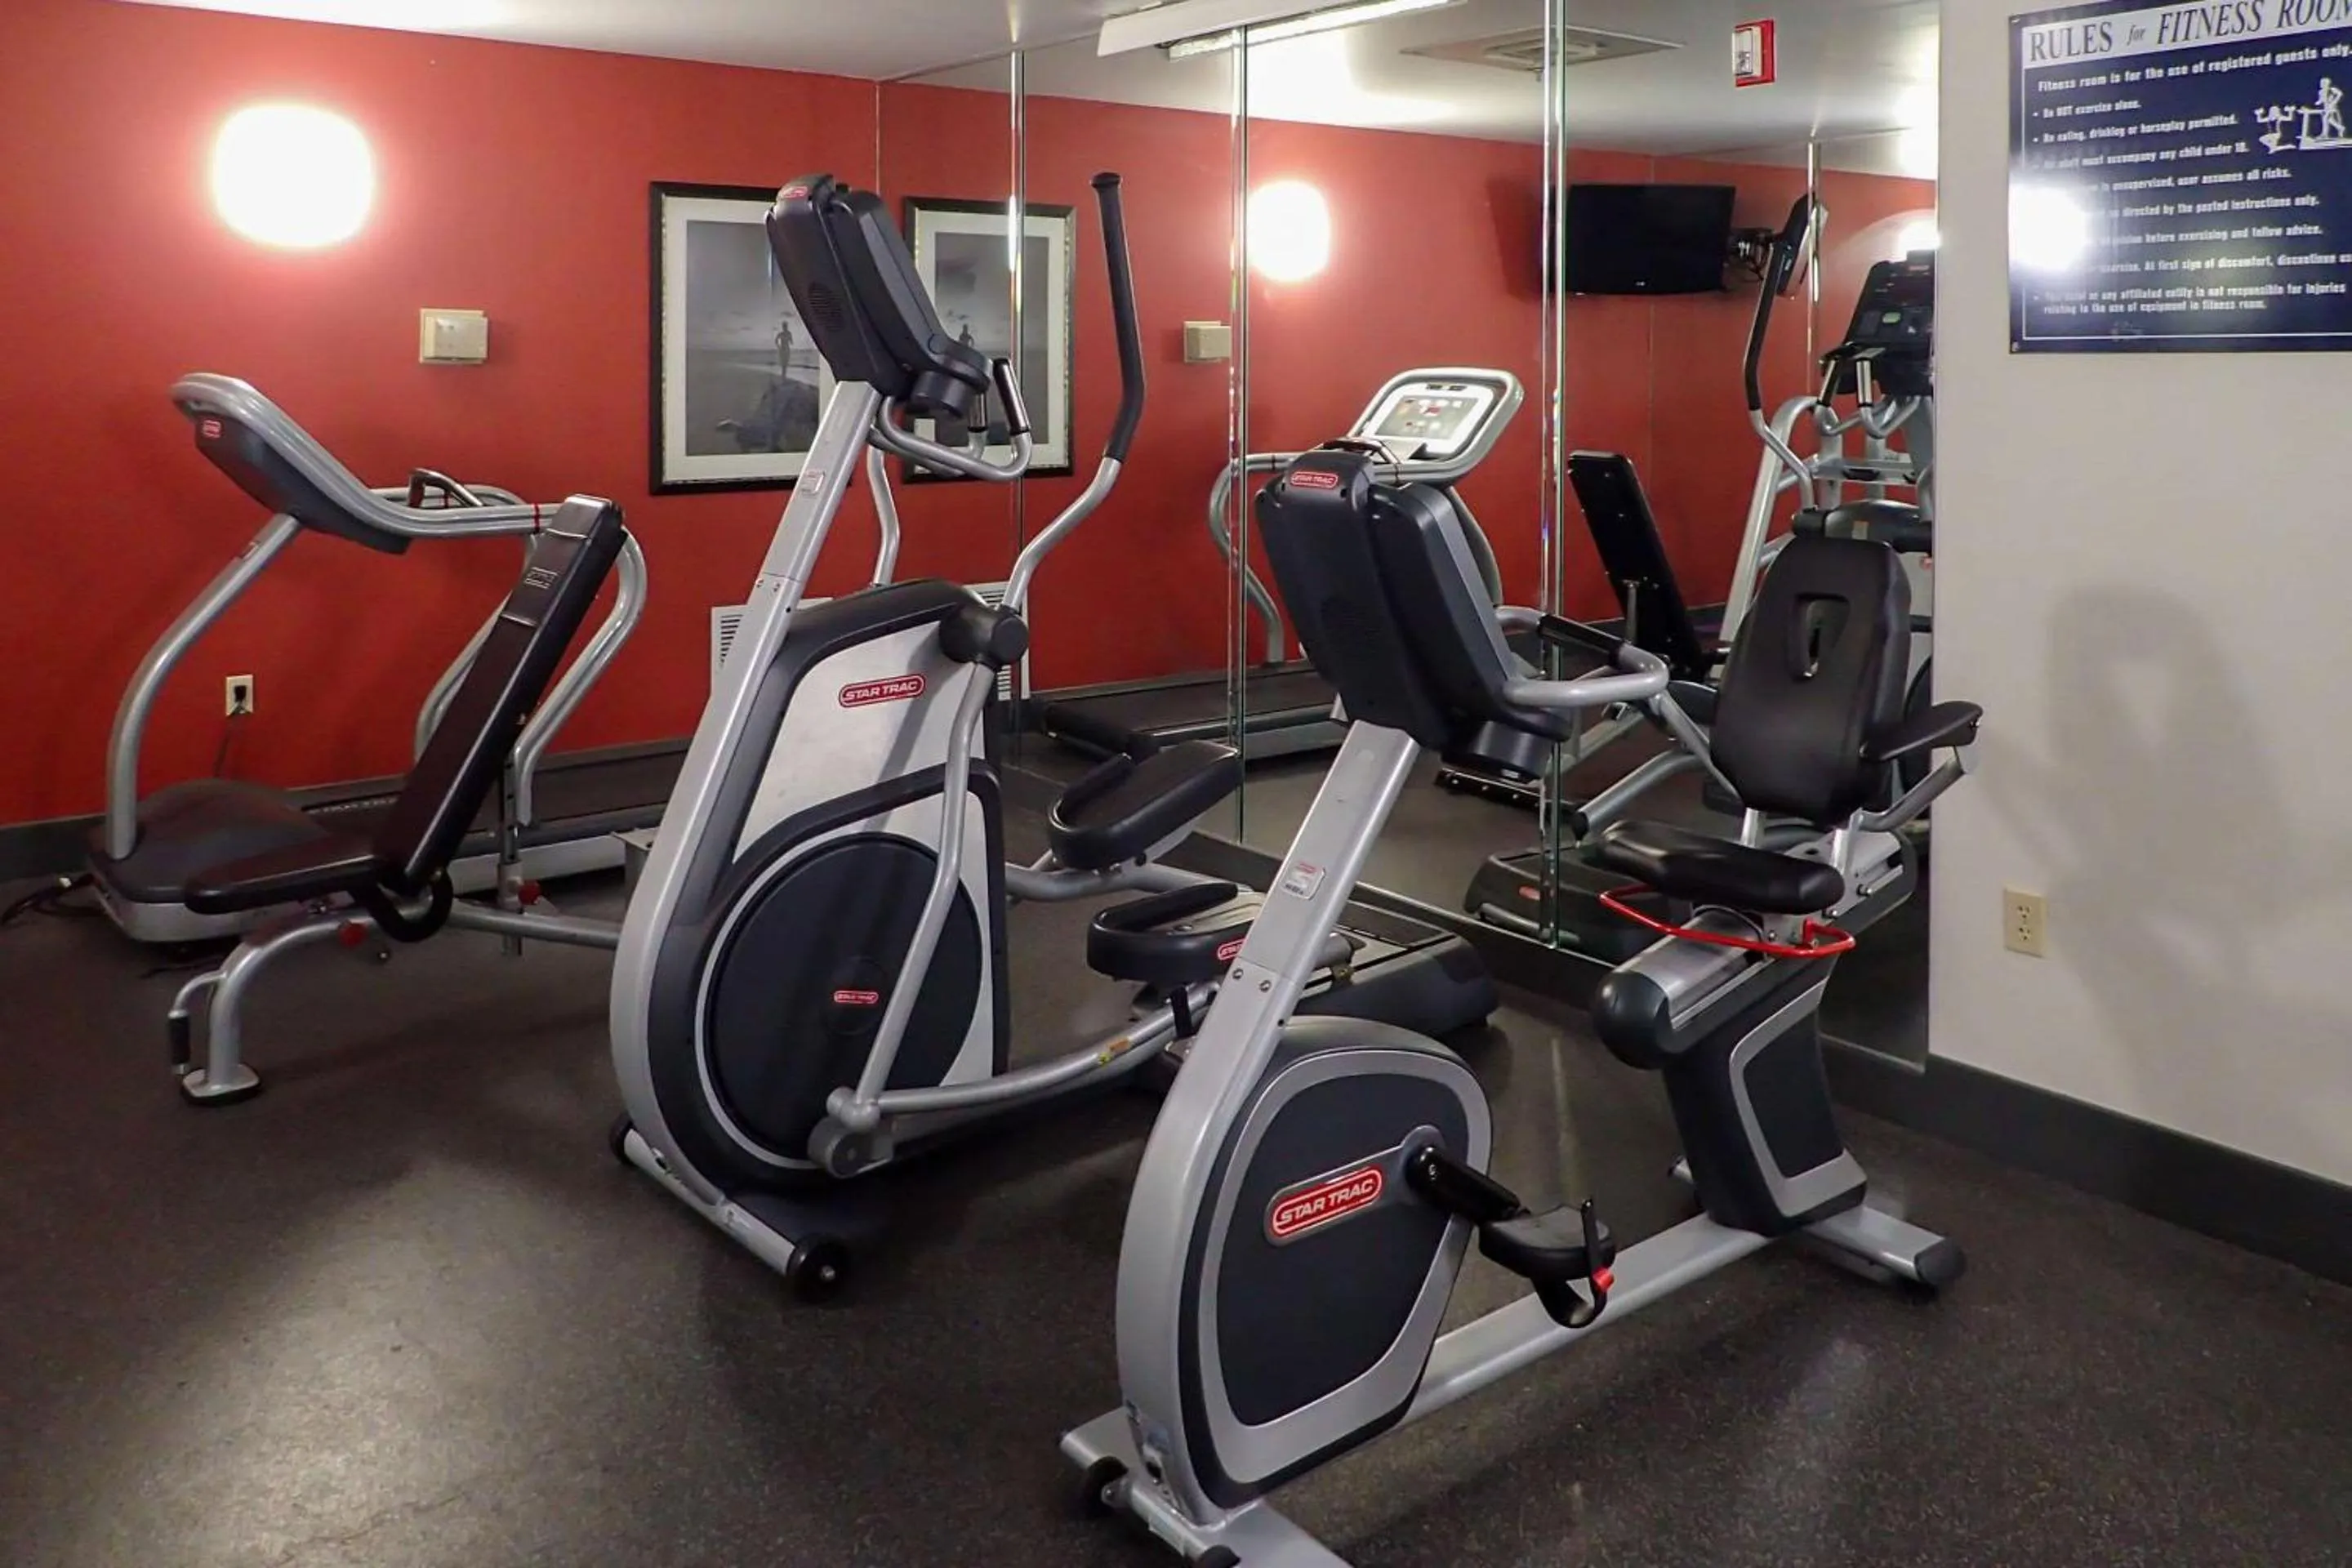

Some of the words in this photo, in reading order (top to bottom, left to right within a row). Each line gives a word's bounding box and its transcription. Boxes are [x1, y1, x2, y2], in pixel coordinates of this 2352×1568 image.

[2030, 21, 2112, 61] RULES
[2127, 24, 2146, 45] for
[2157, 0, 2265, 44] FITNESS
[2038, 79, 2076, 91] Fitness
[2079, 75, 2106, 87] room
[2110, 73, 2121, 83] is
[2125, 70, 2140, 82] for
[2145, 68, 2163, 79] the
[2168, 65, 2188, 77] use
[2192, 61, 2204, 74] of
[2208, 52, 2272, 72] registered
[2275, 47, 2317, 65] guests
[2322, 43, 2352, 58] only.
[2089, 127, 2125, 138] drinking
[2128, 125, 2138, 136] or
[2140, 120, 2185, 134] horseplay
[2188, 114, 2238, 130] permitted.
[2179, 145, 2202, 158] child
[2205, 143, 2233, 156] under
[2112, 176, 2175, 191] unsupervised,
[2202, 172, 2243, 185] assumes
[2247, 168, 2260, 180] all
[2262, 167, 2292, 179] risks.
[2122, 205, 2160, 217] directed
[2163, 203, 2175, 216] by
[2177, 203, 2194, 214] the
[2195, 199, 2228, 213] posted
[2230, 196, 2292, 210] instructions
[2294, 194, 2320, 207] only.
[2145, 233, 2175, 243] before
[2178, 229, 2228, 242] exercising
[2230, 228, 2248, 239] and
[2252, 225, 2283, 238] follow
[2286, 224, 2323, 236] advice.
[2182, 259, 2202, 271] sign
[2204, 258, 2215, 269] of
[2218, 255, 2274, 269] discomfort,
[2277, 252, 2336, 266] discontinue
[2120, 287, 2163, 300] affiliated
[2166, 287, 2193, 299] entity
[2195, 285, 2205, 296] is
[2207, 286, 2225, 296] not
[2227, 283, 2284, 297] responsible
[2287, 283, 2302, 295] for
[2305, 281, 2346, 295] injuries
[2091, 301, 2105, 314] the
[2109, 302, 2125, 314] use
[2127, 301, 2137, 313] of
[2140, 300, 2186, 314] equipment
[2203, 298, 2235, 310] fitness
[2238, 299, 2267, 310] room.
[843, 687, 880, 701] STAR
[883, 681, 918, 694] TRAC
[1275, 1196, 1326, 1226] STAR
[1328, 1178, 1374, 1207] TRAC
